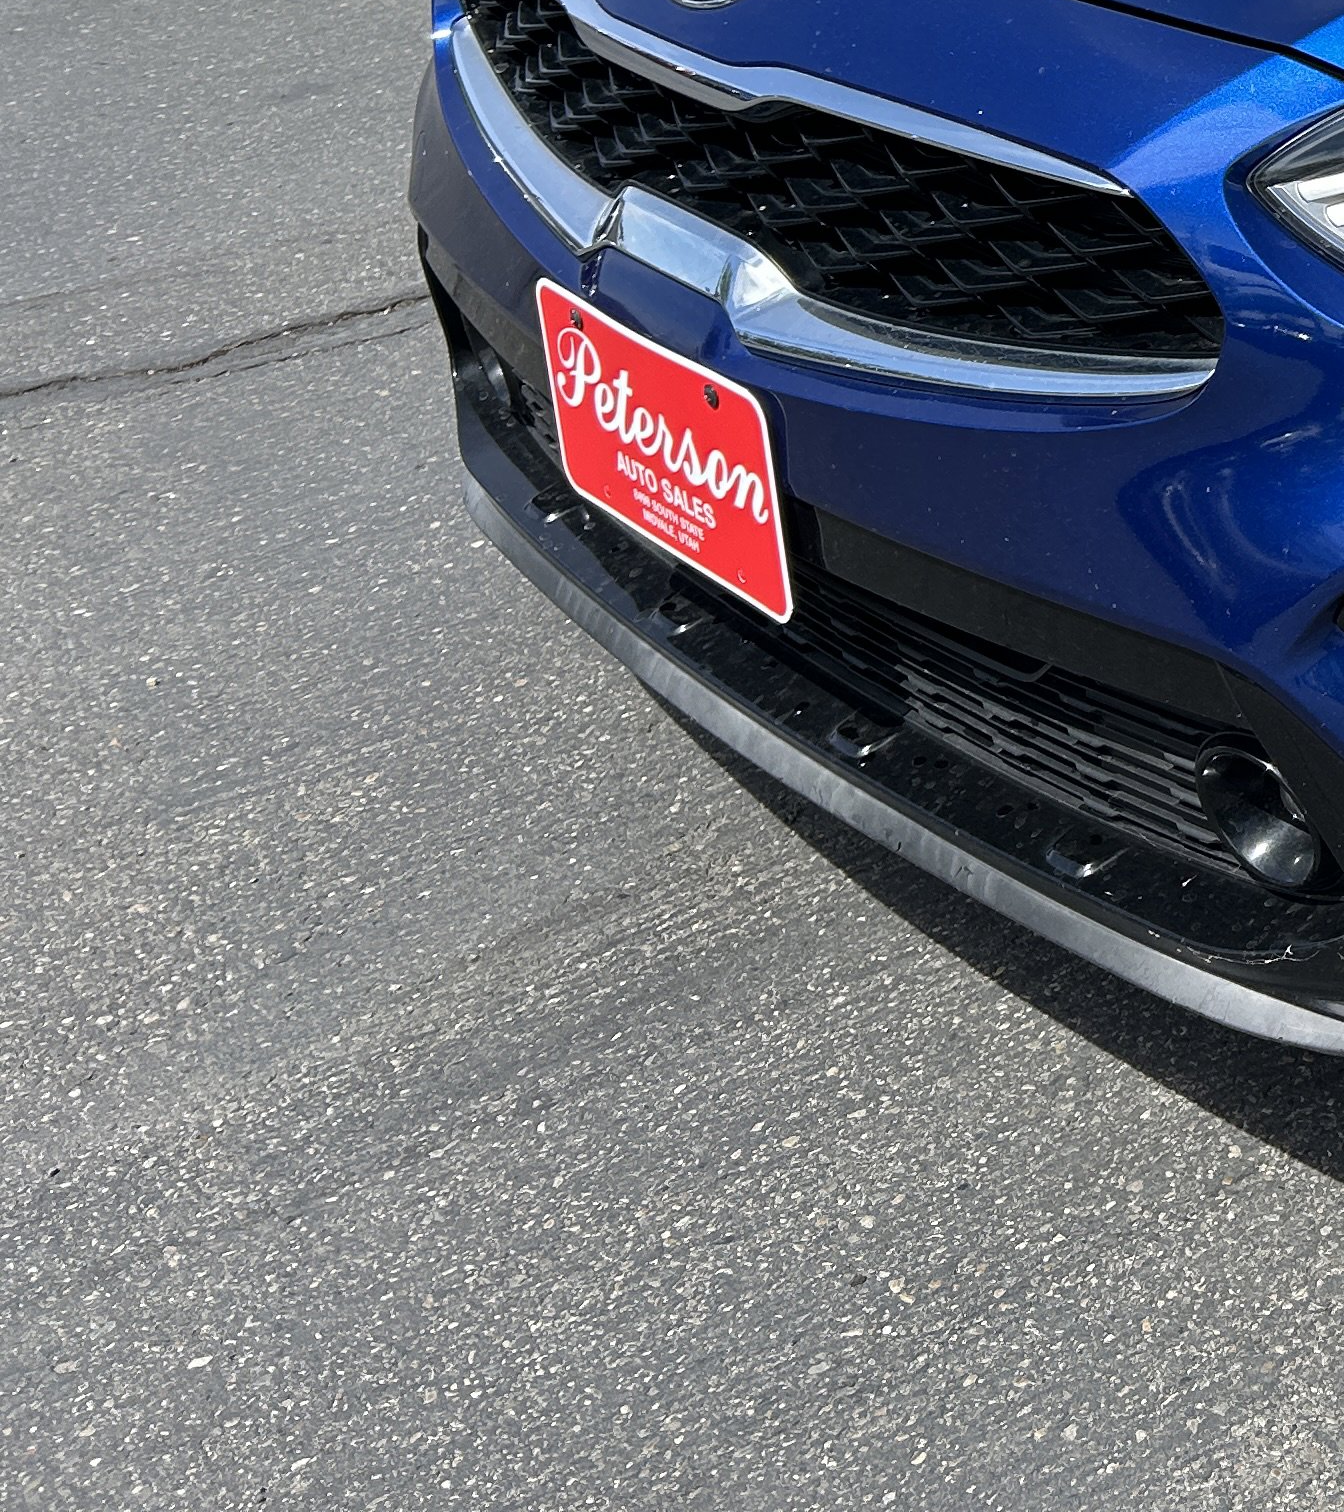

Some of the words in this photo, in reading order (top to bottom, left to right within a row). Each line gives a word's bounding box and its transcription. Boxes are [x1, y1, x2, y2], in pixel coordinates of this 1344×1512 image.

[557, 327, 769, 525] Peterson
[617, 451, 658, 494] AUTO
[660, 478, 717, 529] SALES
